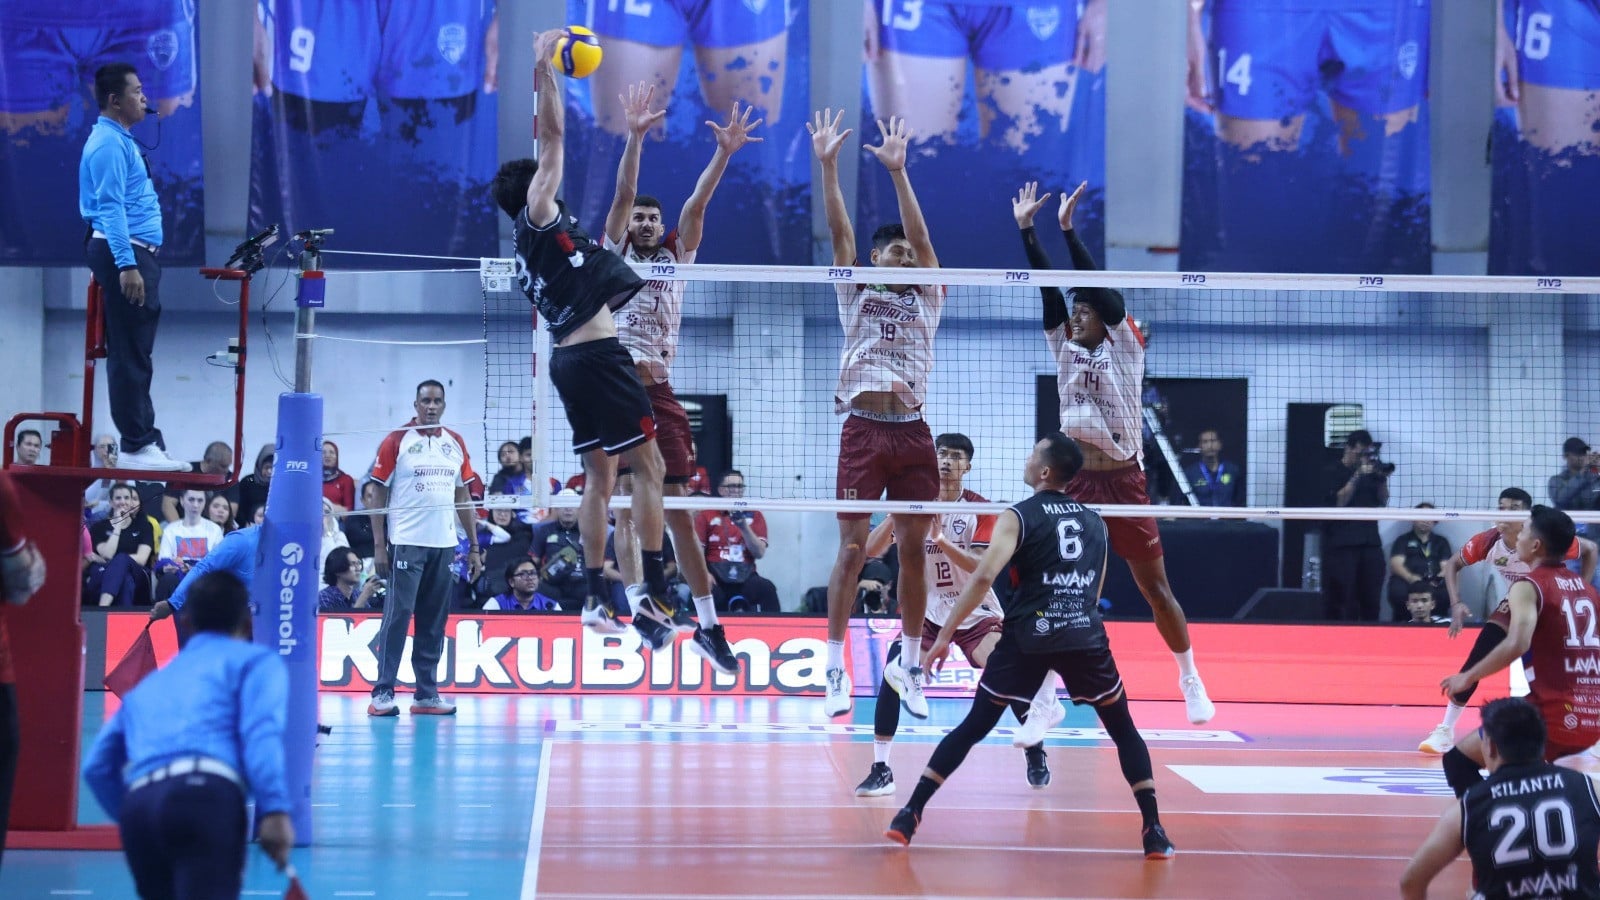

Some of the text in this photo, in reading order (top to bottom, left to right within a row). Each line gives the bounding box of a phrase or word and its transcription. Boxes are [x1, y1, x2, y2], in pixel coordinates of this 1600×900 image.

[290, 27, 315, 73] 9
[1218, 48, 1252, 96] 14
[880, 323, 896, 341] 18
[1084, 371, 1100, 391] 14
[1057, 518, 1083, 561] 6
[935, 562, 952, 580] 12
[279, 568, 299, 656] Senoh
[1562, 597, 1600, 648] 12
[1490, 773, 1565, 799] KILANTA
[1489, 798, 1578, 867] 20
[1505, 864, 1578, 898] LAVANI
